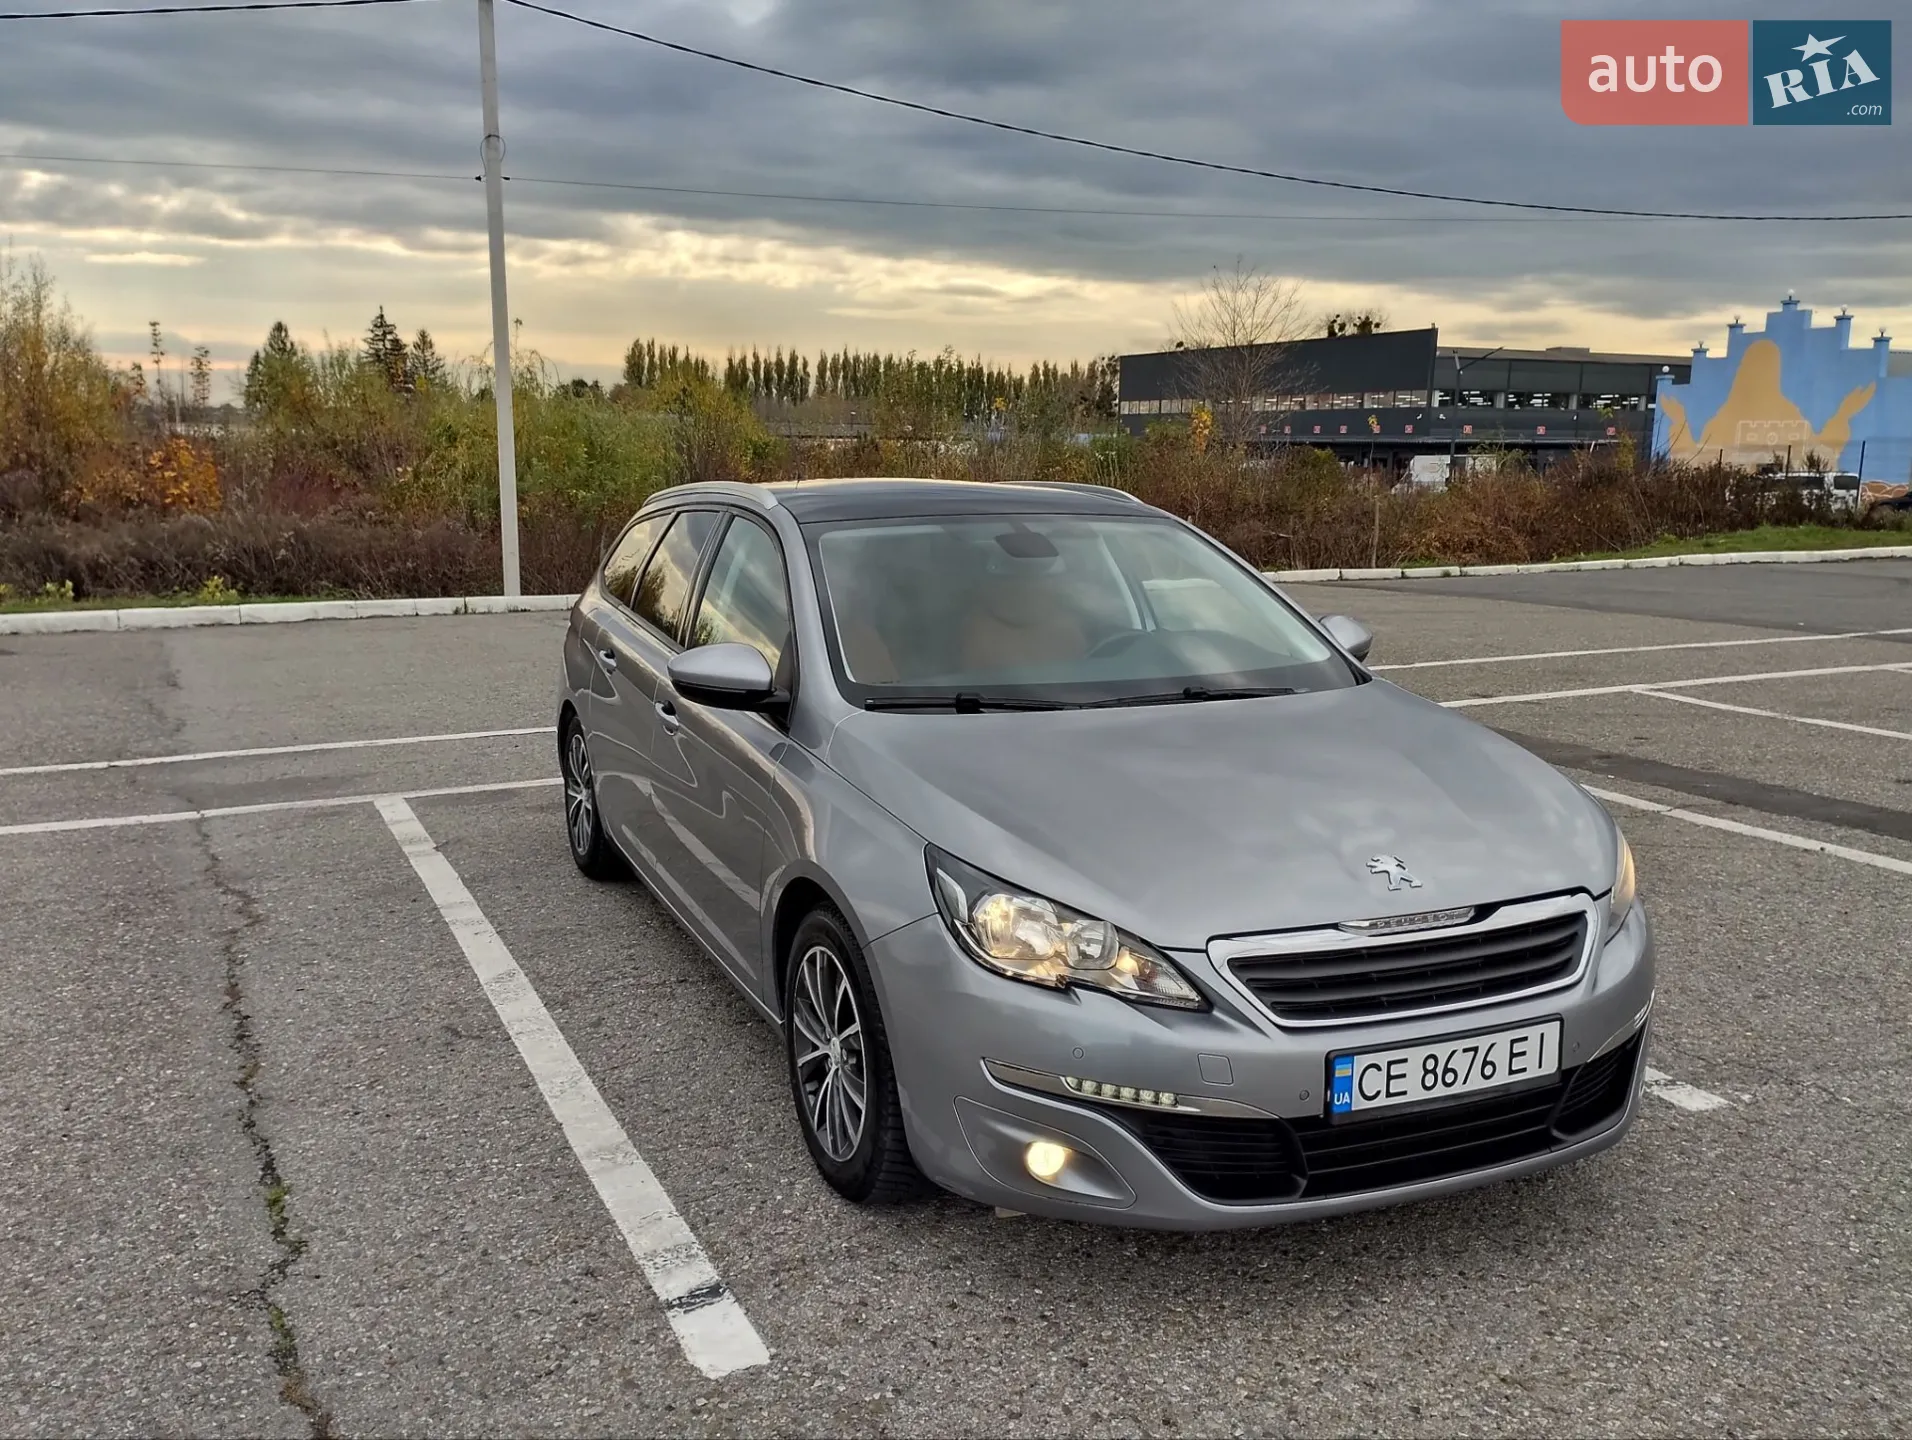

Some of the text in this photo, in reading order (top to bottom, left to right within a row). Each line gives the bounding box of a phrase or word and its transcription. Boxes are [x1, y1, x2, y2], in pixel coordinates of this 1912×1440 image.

[1358, 1032, 1545, 1101] CE 8676 EI
[1334, 1091, 1351, 1105] UA
